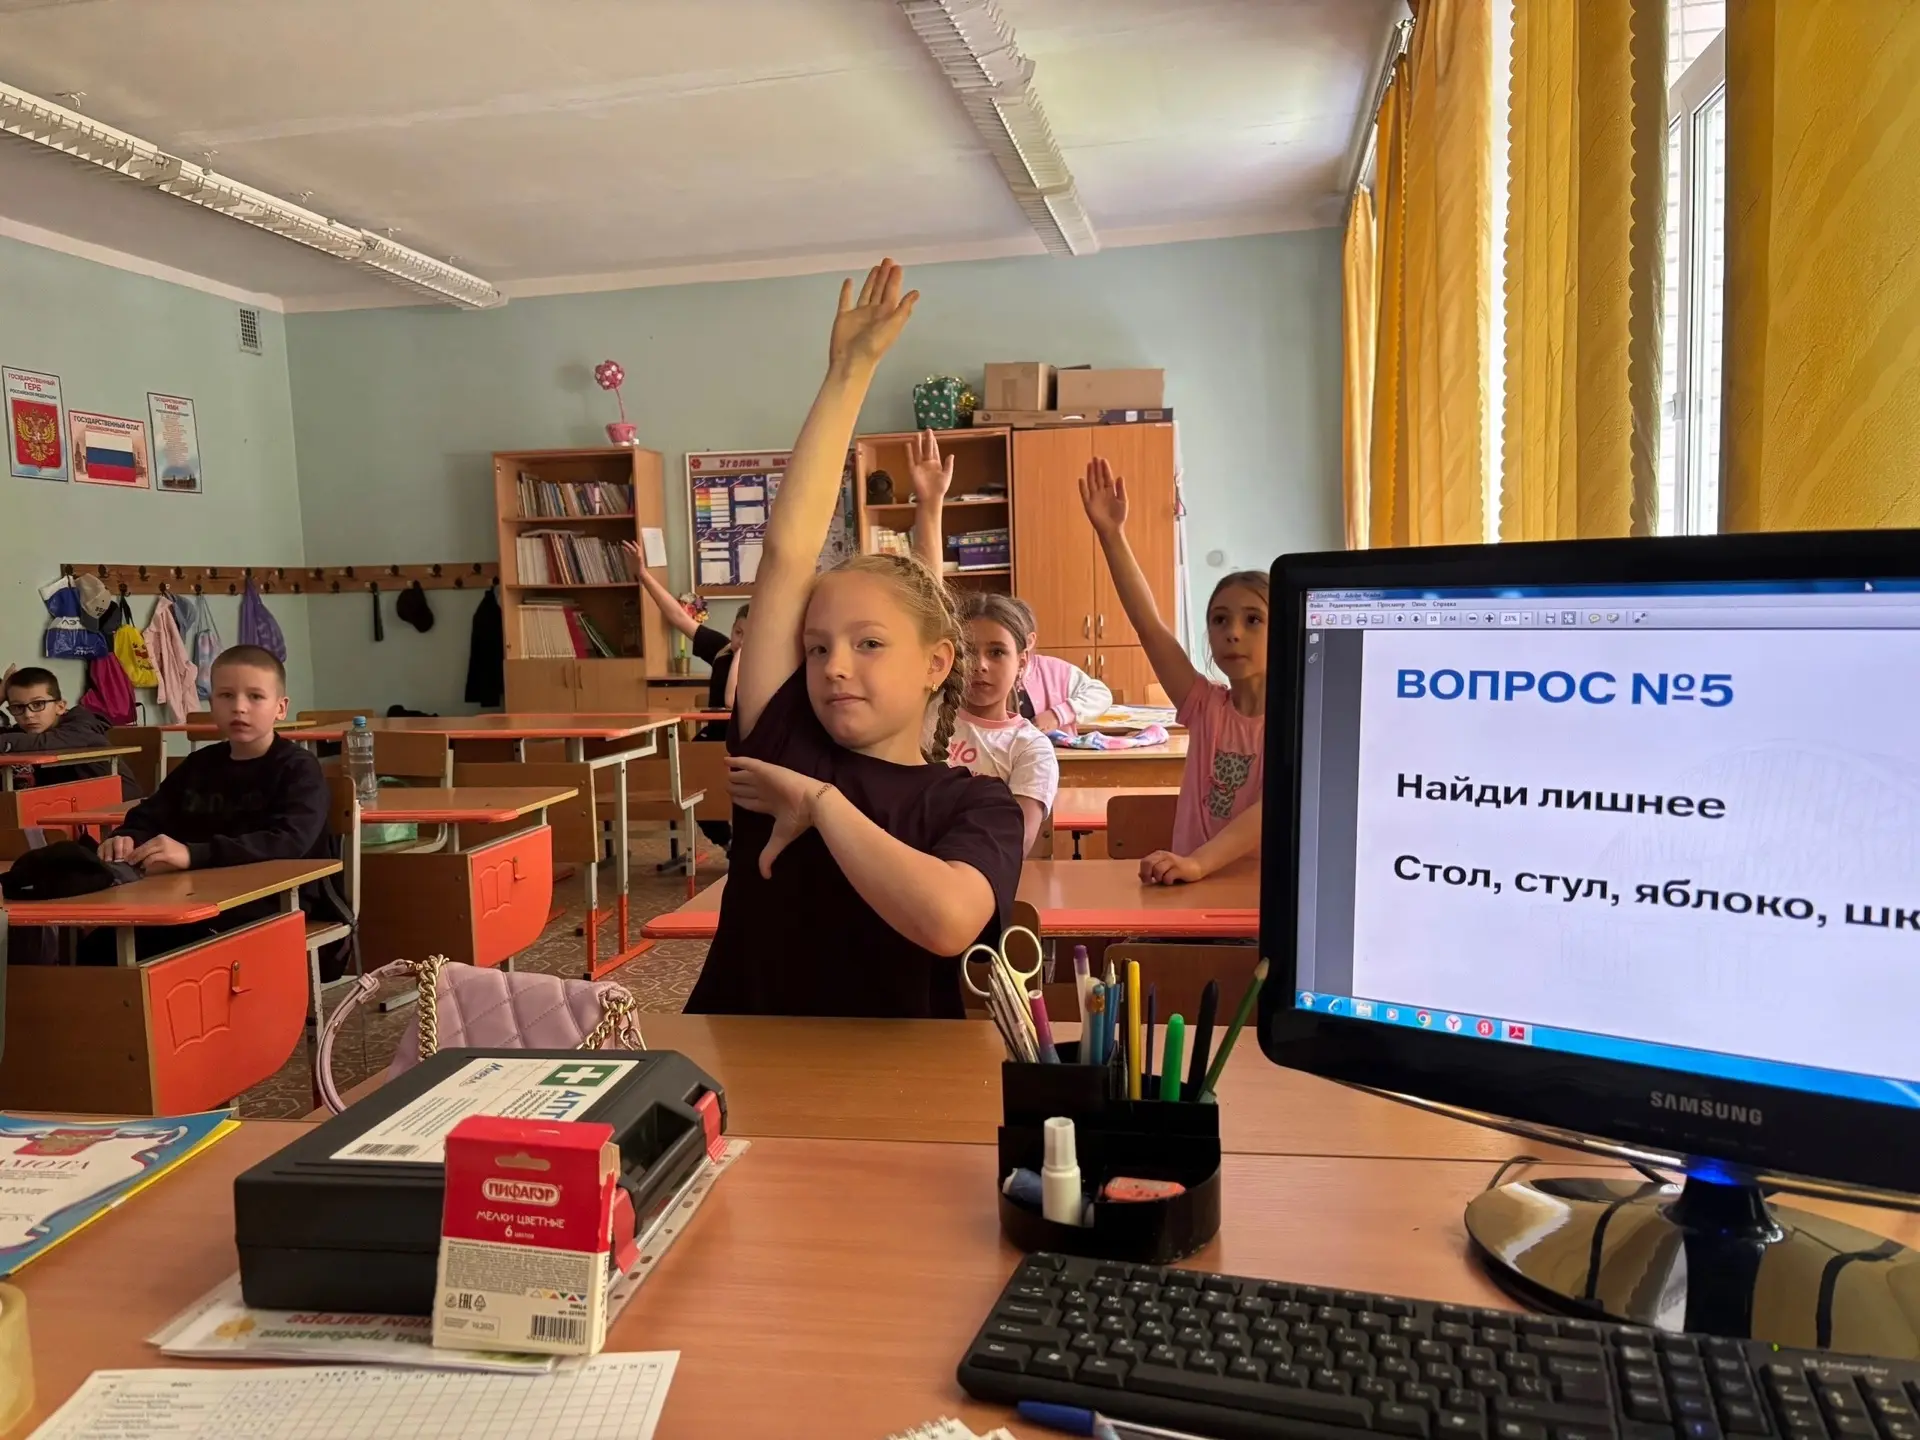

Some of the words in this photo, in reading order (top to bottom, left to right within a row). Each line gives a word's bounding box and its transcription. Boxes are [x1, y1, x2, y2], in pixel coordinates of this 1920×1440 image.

[24, 382, 42, 392] ГЕРБ
[73, 415, 126, 429] ГОСУДАРСТВЕННЫЙ
[126, 422, 140, 430] ФЛАГ
[1397, 669, 1616, 704] ВОПРОС
[1632, 672, 1734, 707] №5
[1396, 773, 1528, 808] Найди
[1538, 786, 1726, 819] лишнее
[1394, 854, 1502, 894] Стол,
[1514, 871, 1619, 907] стул,
[1634, 879, 1828, 928] яблоко,
[1650, 1090, 1763, 1126] SAMSUNG
[488, 1182, 555, 1202] ПИФАГОР
[476, 1210, 514, 1222] МЕЛКИ
[517, 1214, 566, 1229] ЦВЕТНЫЕ
[504, 1226, 512, 1238] 6
